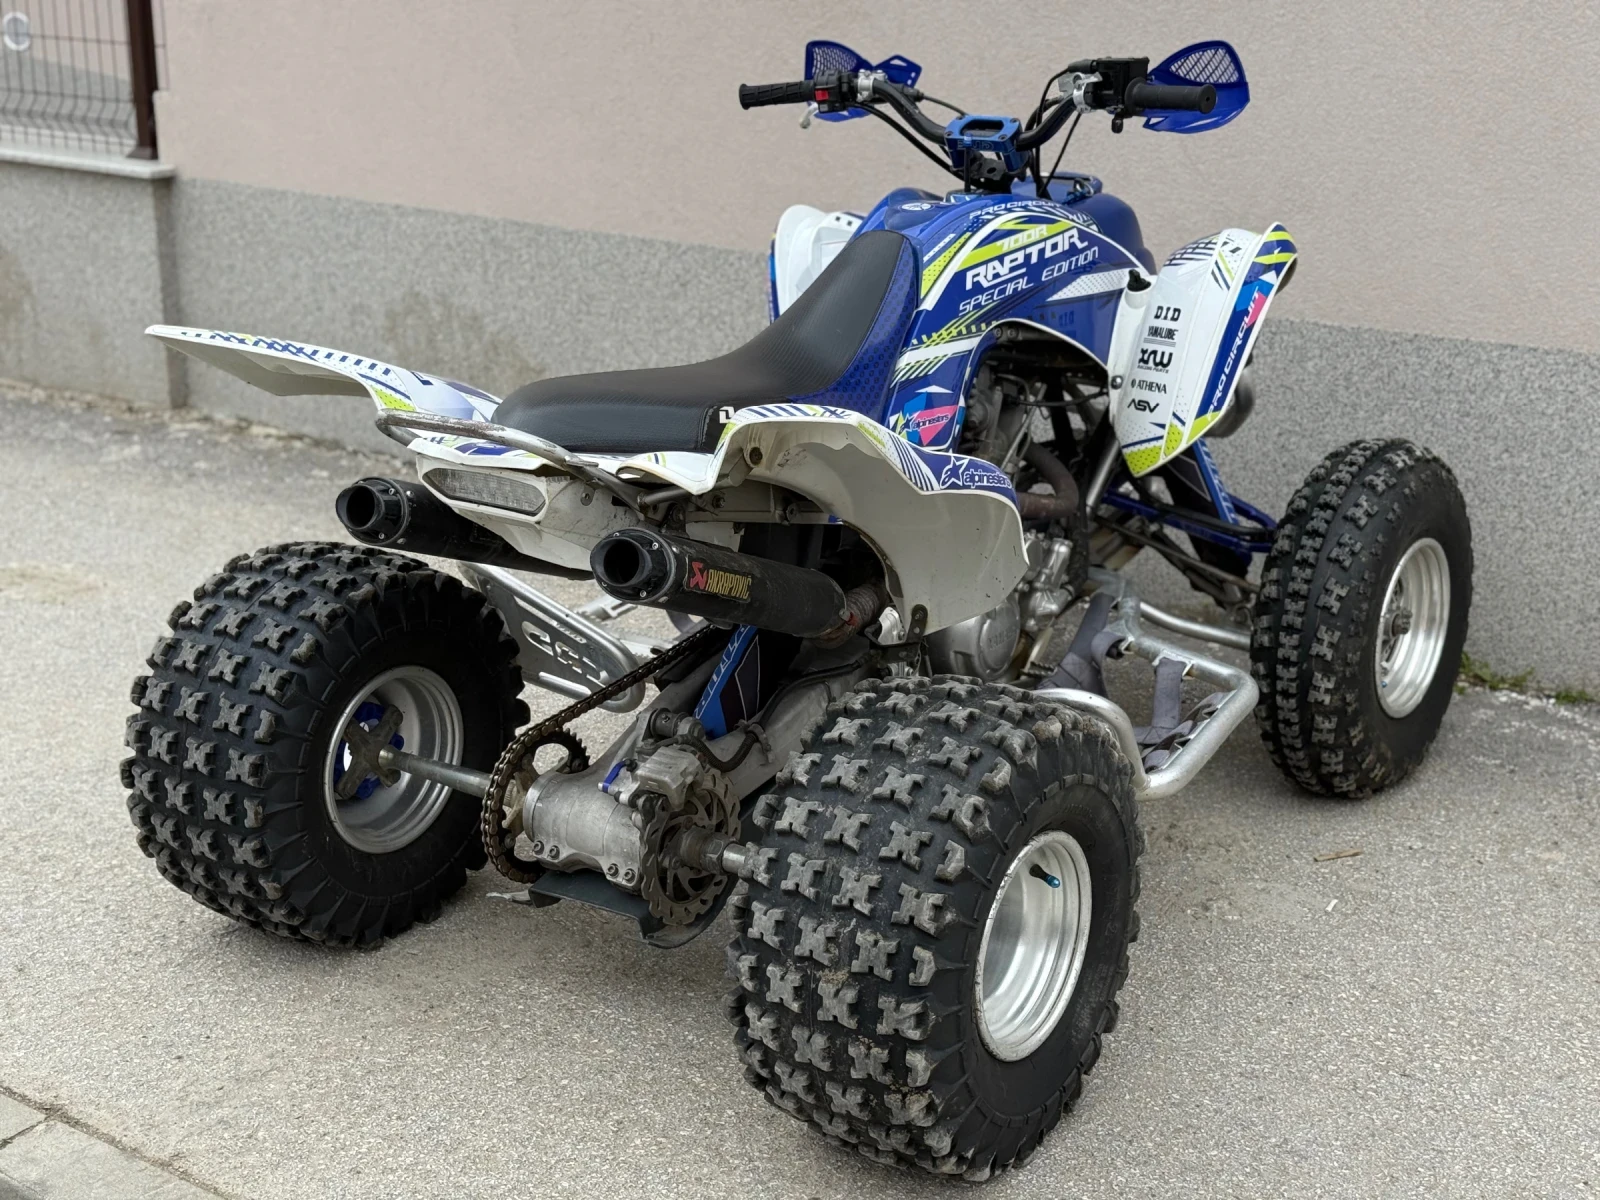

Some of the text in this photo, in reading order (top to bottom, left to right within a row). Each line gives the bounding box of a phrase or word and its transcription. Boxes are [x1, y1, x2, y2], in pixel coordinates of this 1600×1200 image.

[996, 224, 1048, 252] 700R
[965, 227, 1089, 291] RAPTOR
[958, 245, 1099, 316] SPECIAL EDITION
[1136, 380, 1167, 395] ATHENA
[1127, 398, 1160, 413] ASV
[911, 413, 950, 431] alpinestars
